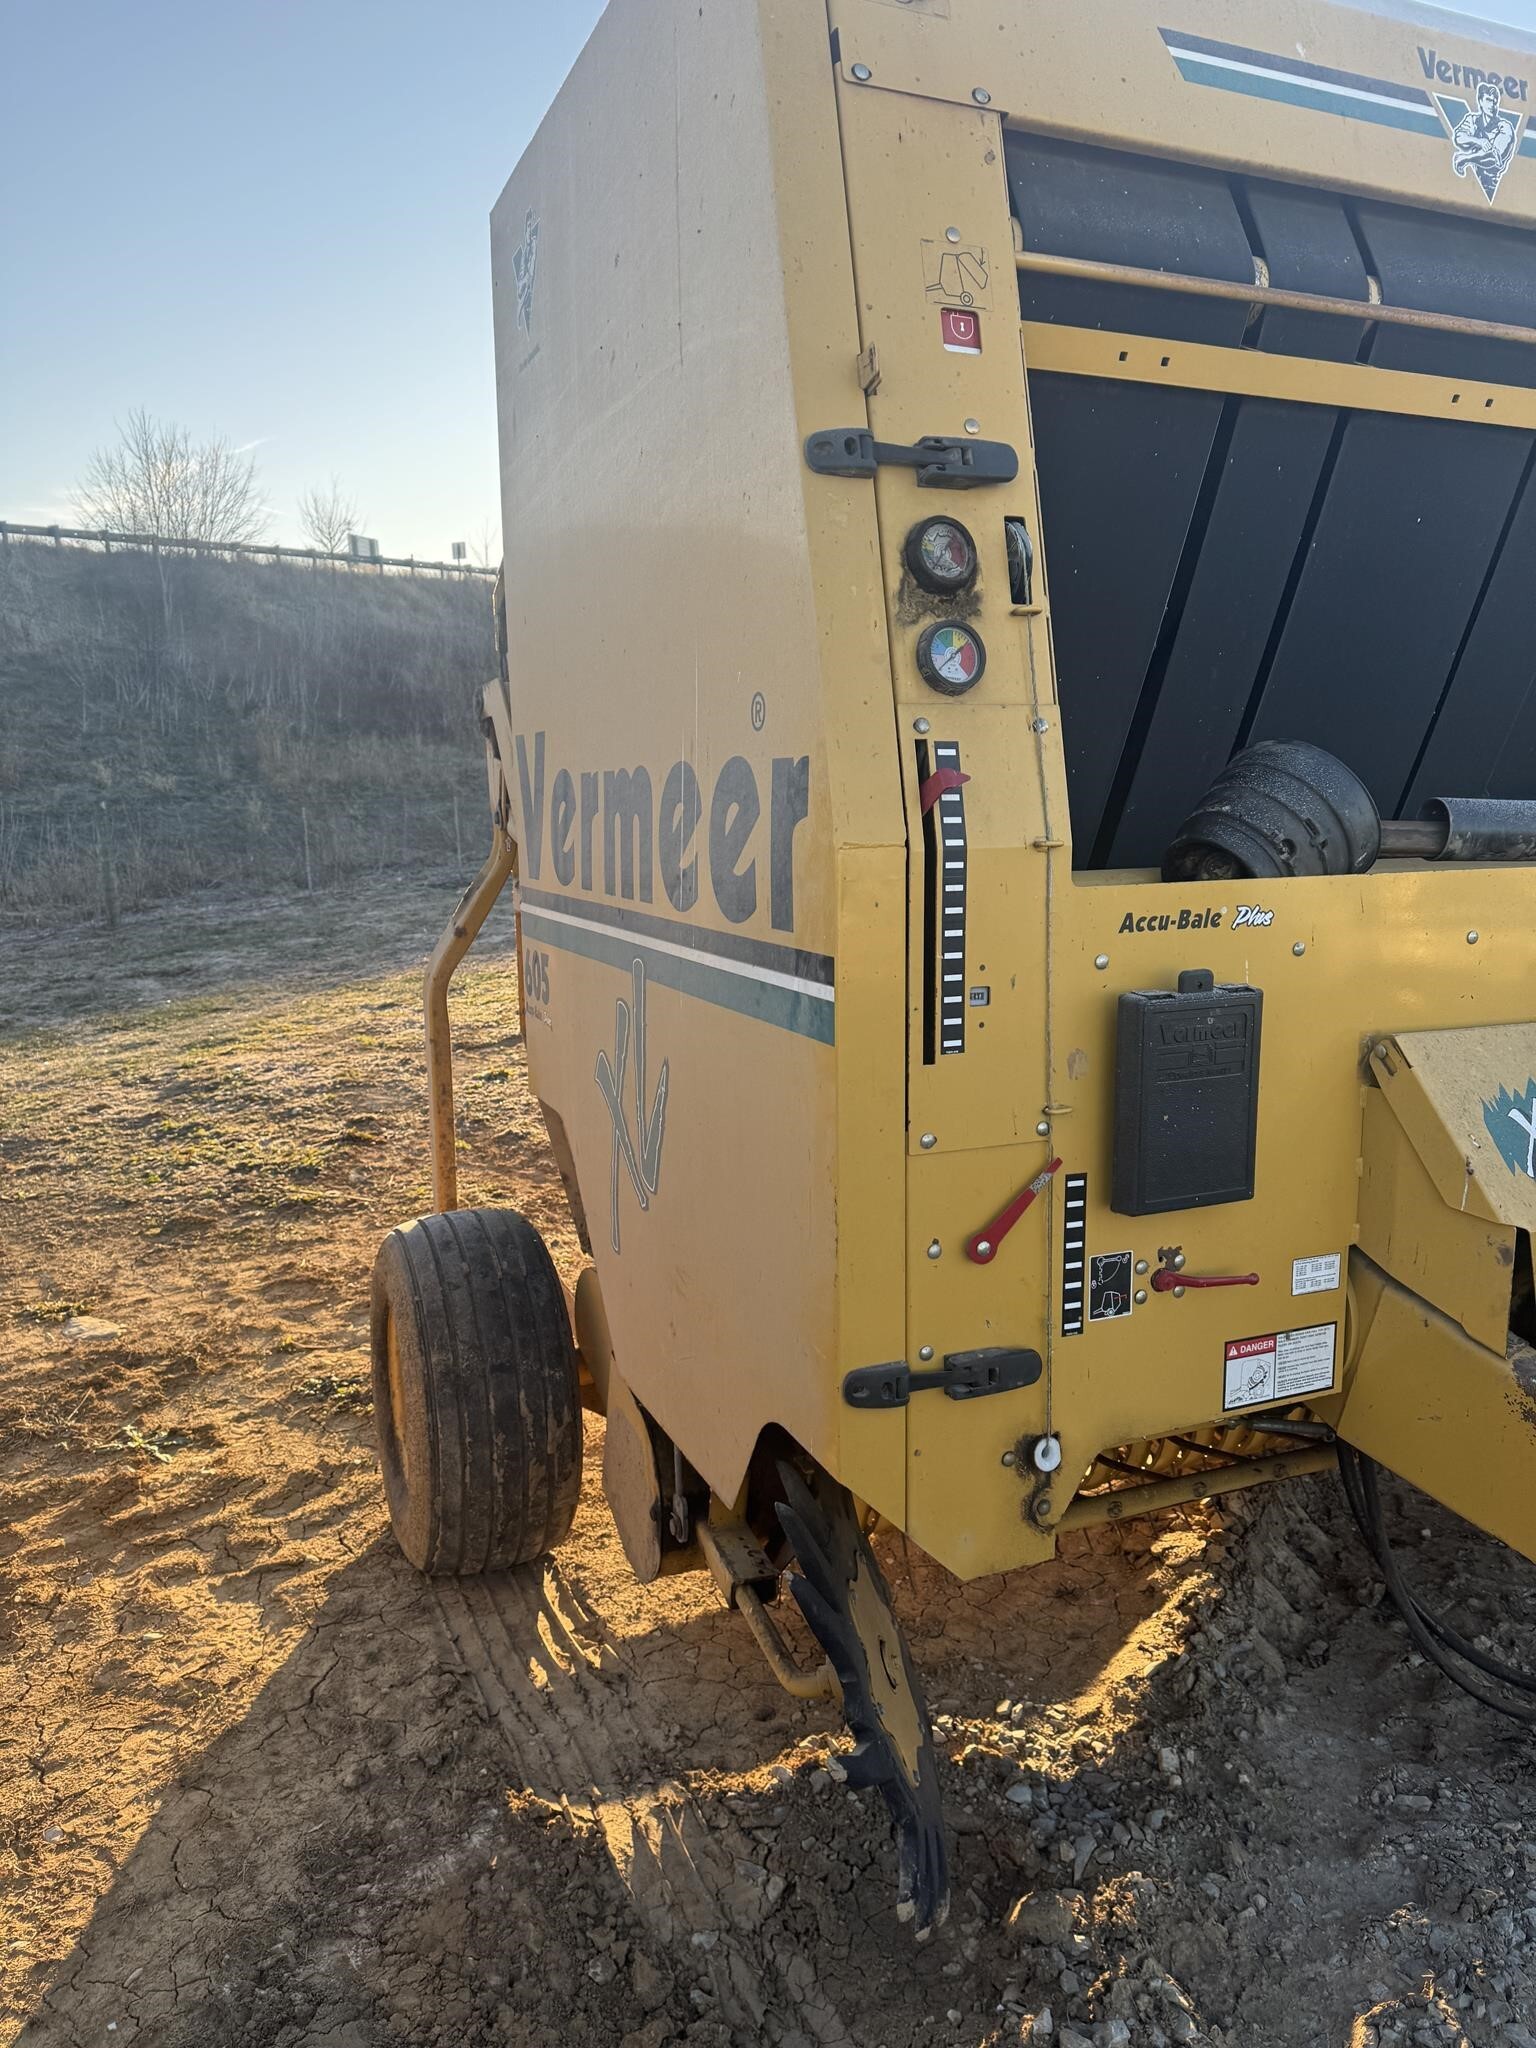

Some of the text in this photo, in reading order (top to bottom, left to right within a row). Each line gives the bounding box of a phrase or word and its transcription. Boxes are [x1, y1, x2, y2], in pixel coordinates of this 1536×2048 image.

[1417, 46, 1528, 101] Vermeer
[515, 731, 810, 933] Vermeer
[1118, 904, 1275, 934] Accu-Bale Plus
[524, 948, 550, 1006] 605
[1240, 1340, 1275, 1354] DANGER
